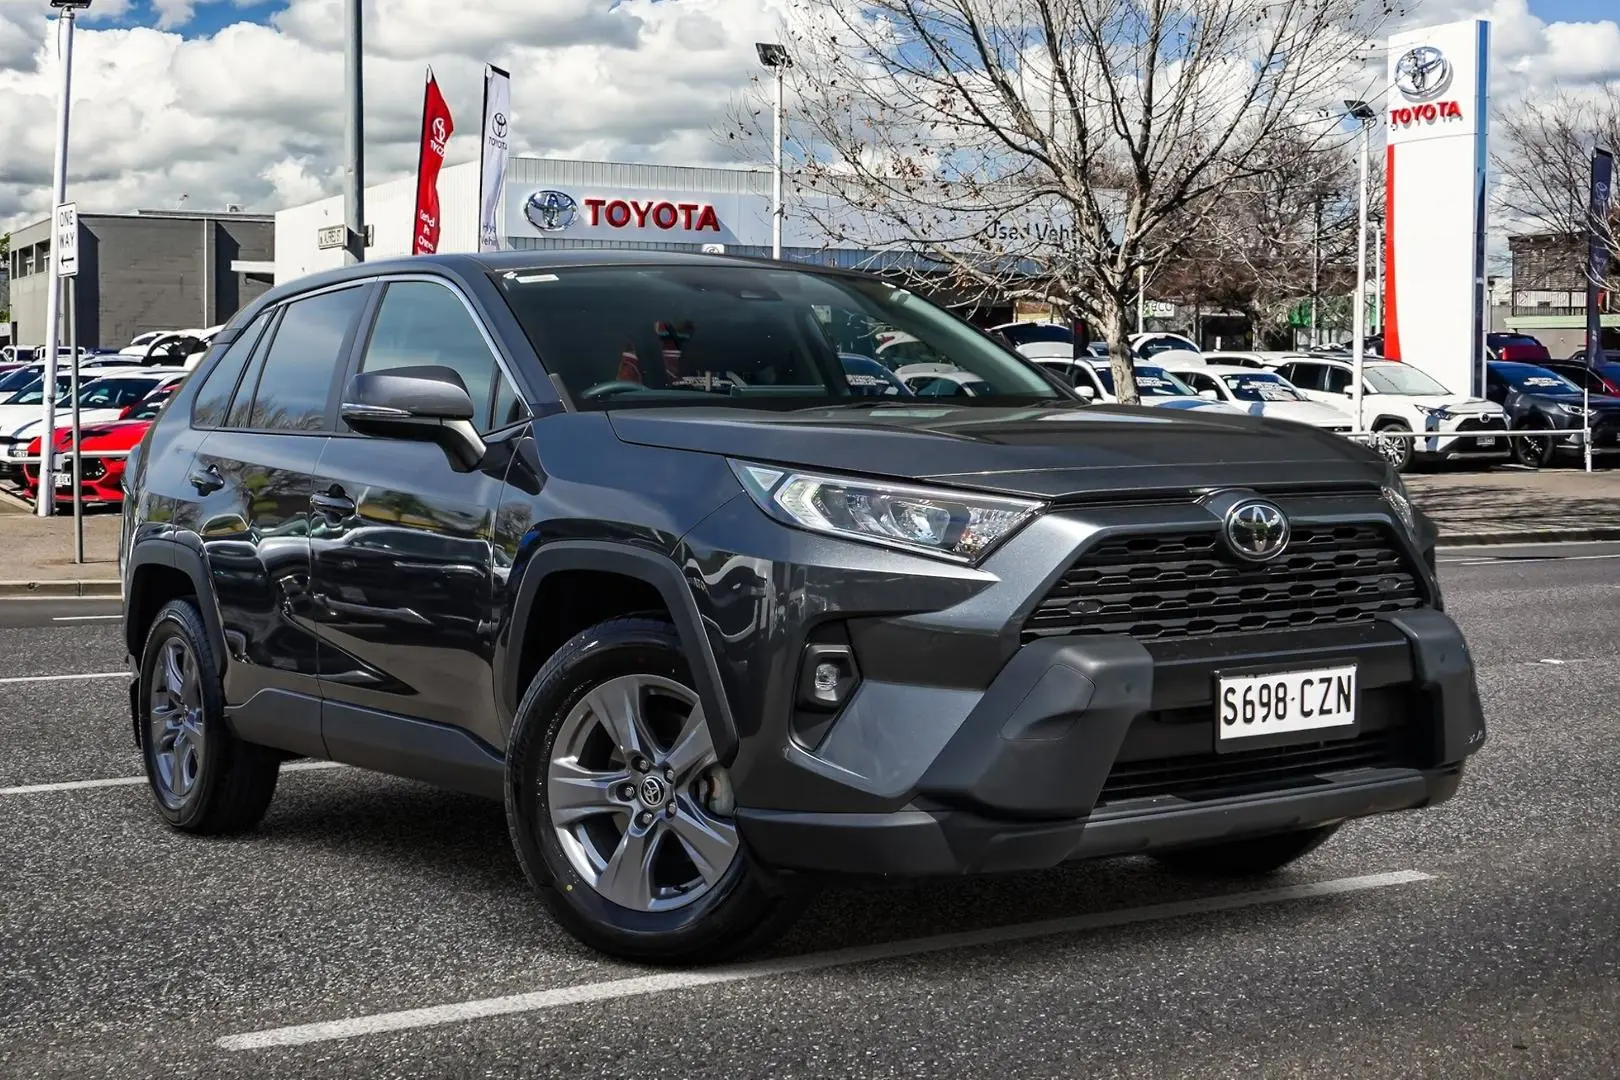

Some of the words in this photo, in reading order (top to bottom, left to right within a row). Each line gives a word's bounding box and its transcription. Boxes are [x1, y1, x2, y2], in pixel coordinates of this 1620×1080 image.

[1389, 101, 1463, 124] TOYOTA
[60, 210, 74, 227] ONE
[584, 199, 721, 231] TOYOTA
[60, 231, 75, 249] WAY
